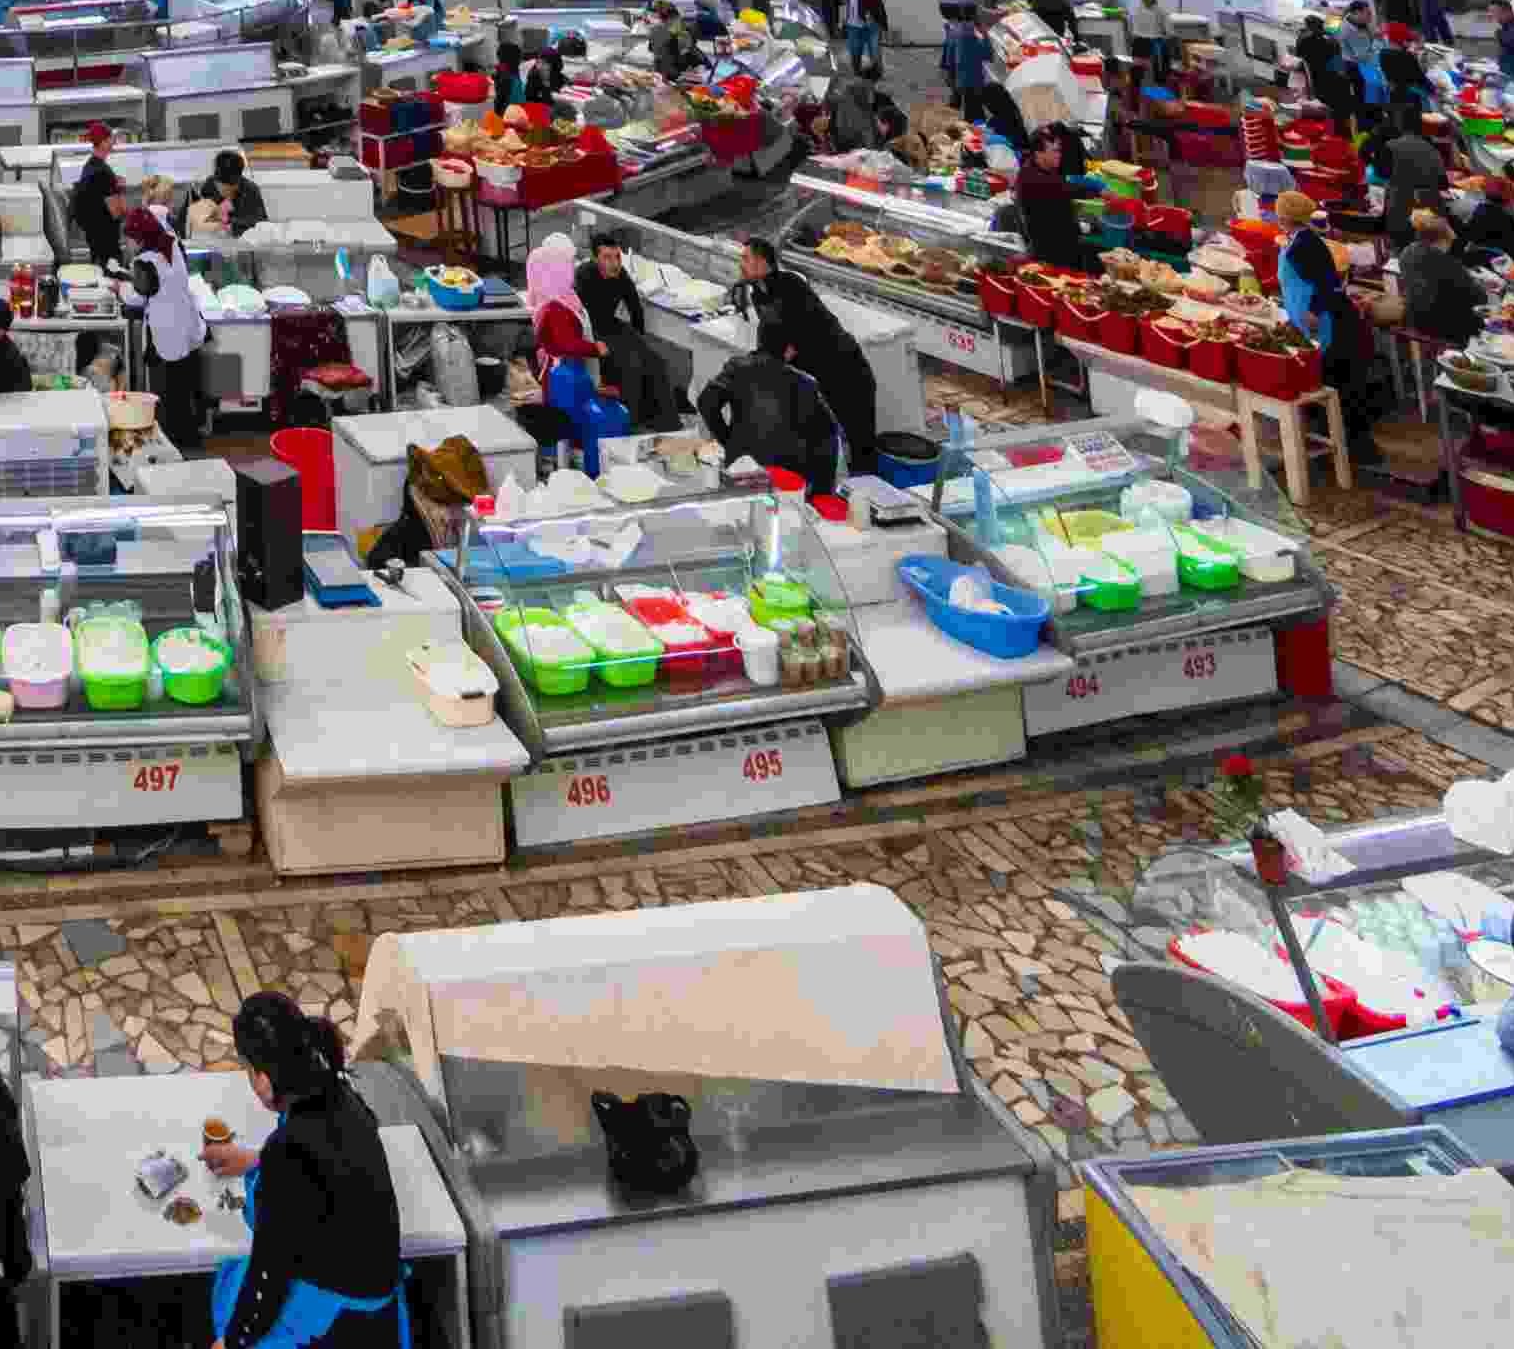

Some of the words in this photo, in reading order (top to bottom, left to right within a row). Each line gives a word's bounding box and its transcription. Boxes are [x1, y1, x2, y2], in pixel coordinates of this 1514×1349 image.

[1065, 672, 1099, 702] 494
[1182, 652, 1216, 680] 493
[132, 763, 182, 794] 497
[565, 773, 612, 808] 496
[741, 748, 784, 781] 495
